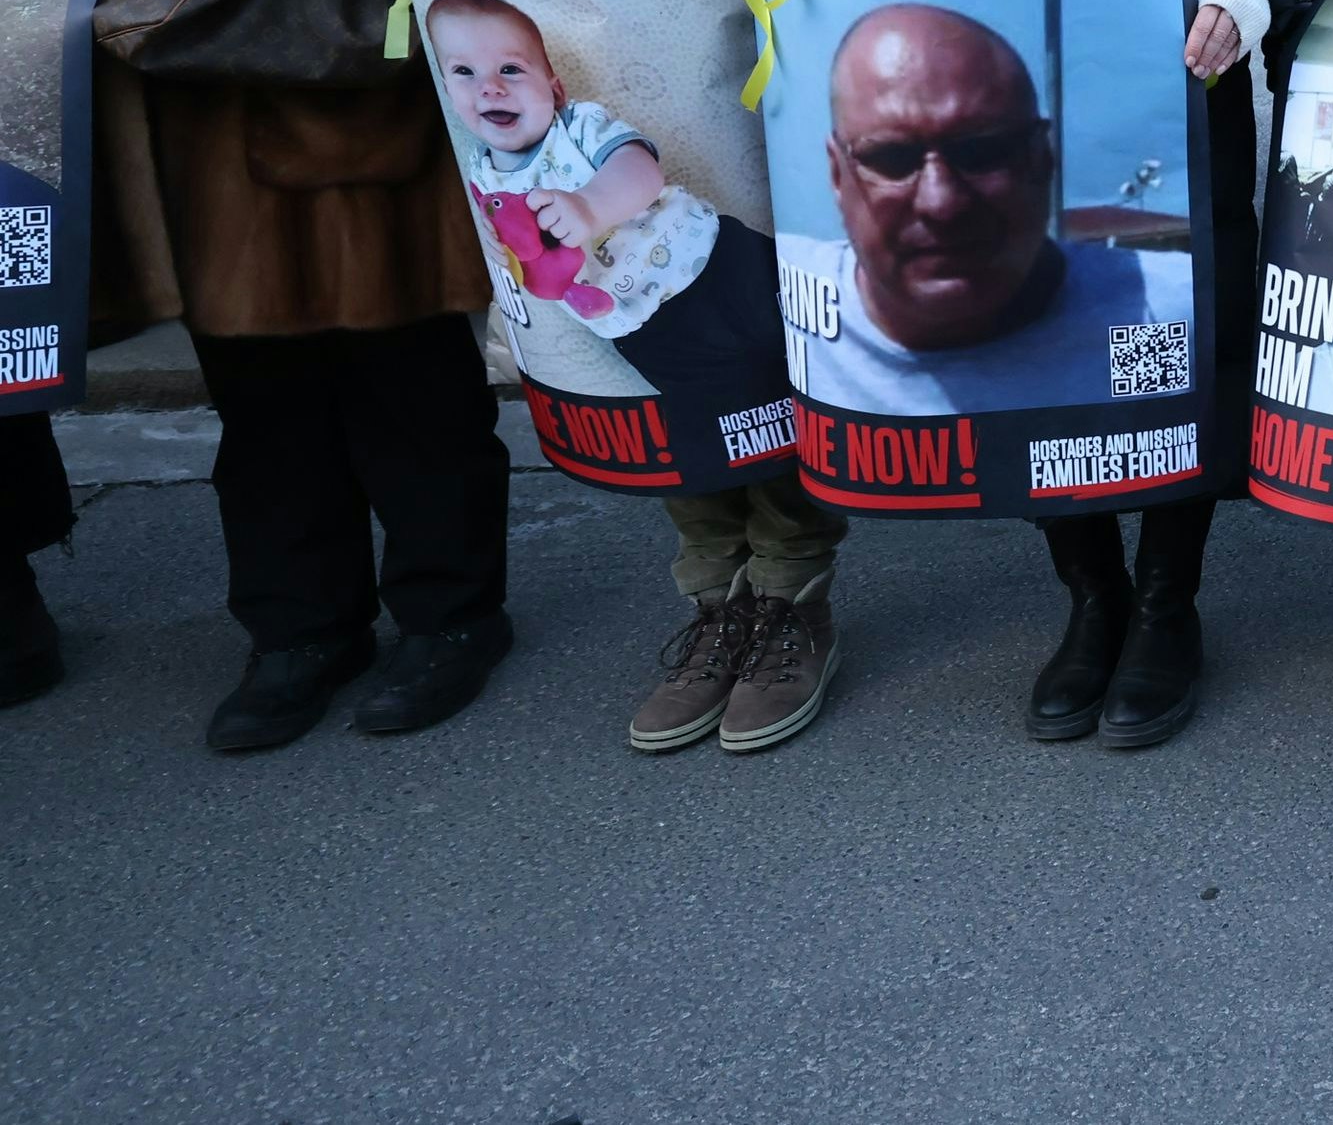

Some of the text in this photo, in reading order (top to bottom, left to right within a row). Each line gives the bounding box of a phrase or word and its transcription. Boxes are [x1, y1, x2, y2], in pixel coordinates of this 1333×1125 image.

[780, 258, 839, 339] RING
[1255, 330, 1316, 408] HIM
[560, 400, 673, 464] NOW!
[718, 397, 794, 434] HOSTAGES
[724, 416, 797, 461] FAMILI
[1029, 422, 1198, 462] HOSTAGES AND MISSING
[846, 418, 979, 486] NOW!
[1031, 442, 1198, 490] FAMILIES FORUM
[1250, 405, 1333, 495] HOME
